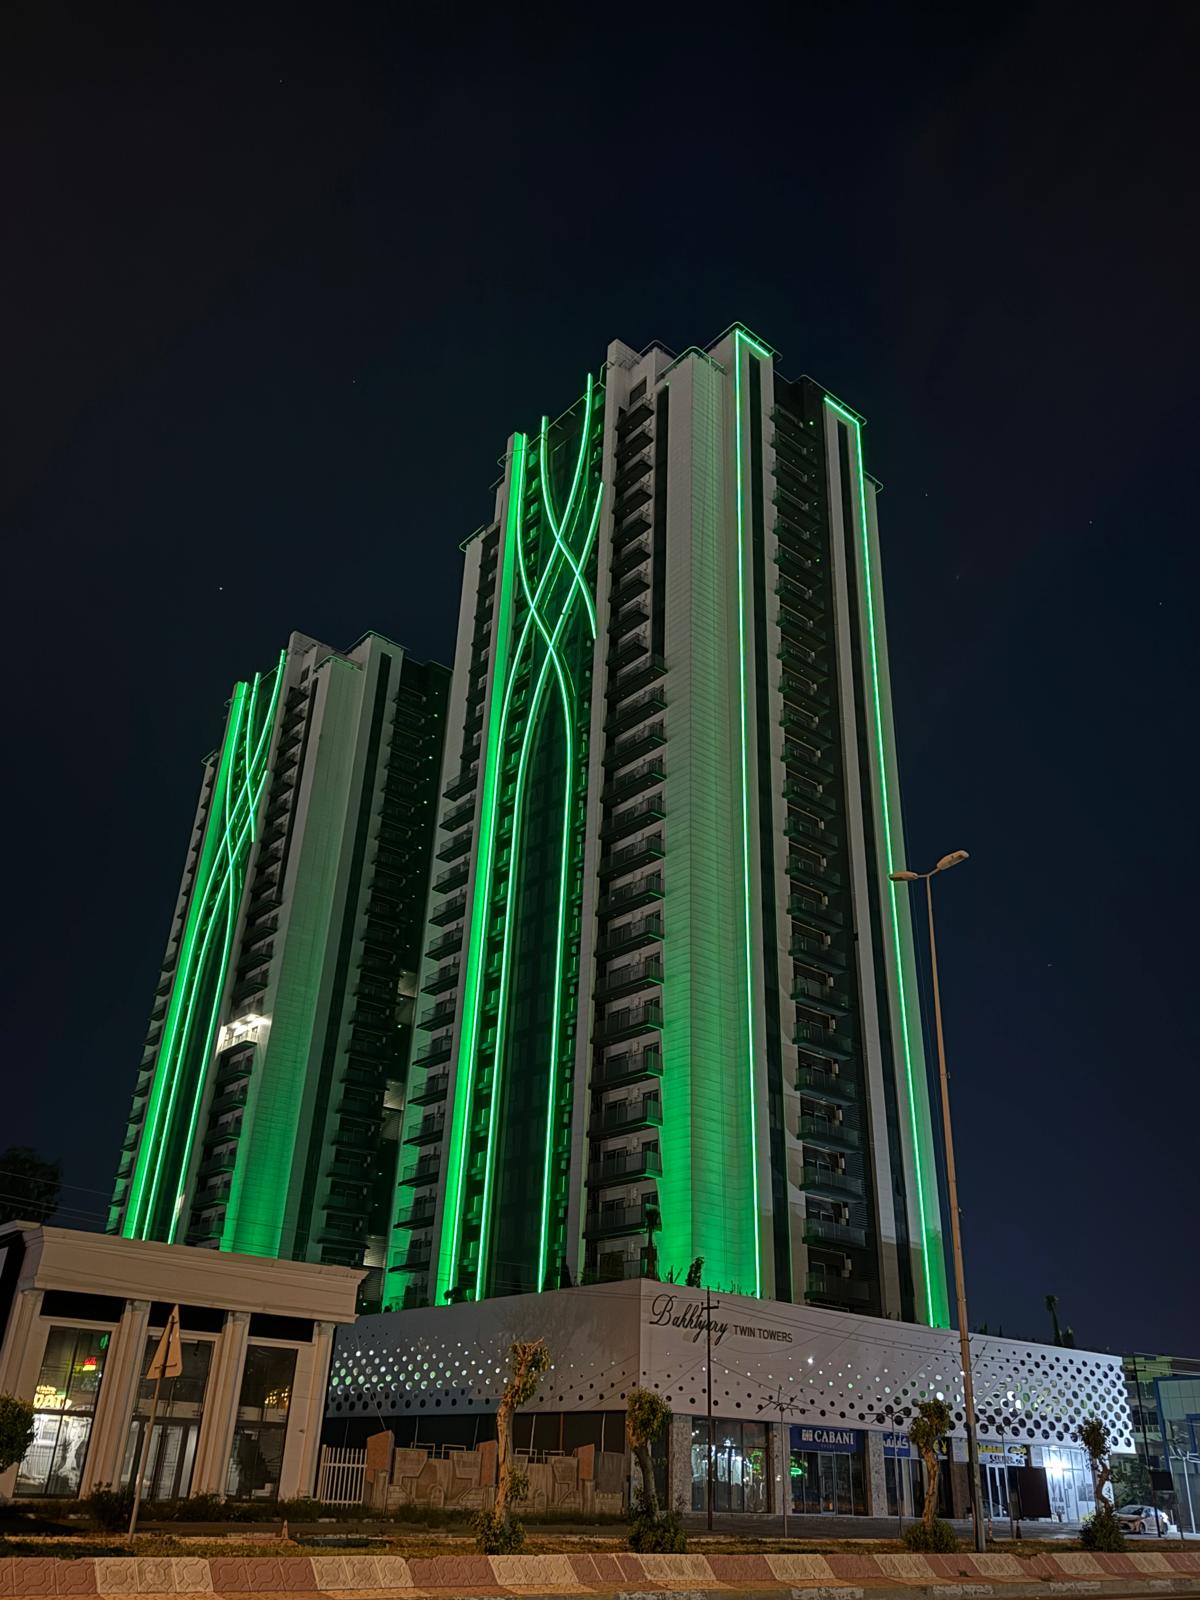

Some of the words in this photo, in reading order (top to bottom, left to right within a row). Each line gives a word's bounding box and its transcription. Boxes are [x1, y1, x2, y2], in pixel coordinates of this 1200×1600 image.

[733, 1324, 756, 1338] TWIN
[757, 1328, 793, 1343] TOWERS
[814, 1430, 854, 1445] CABANI
